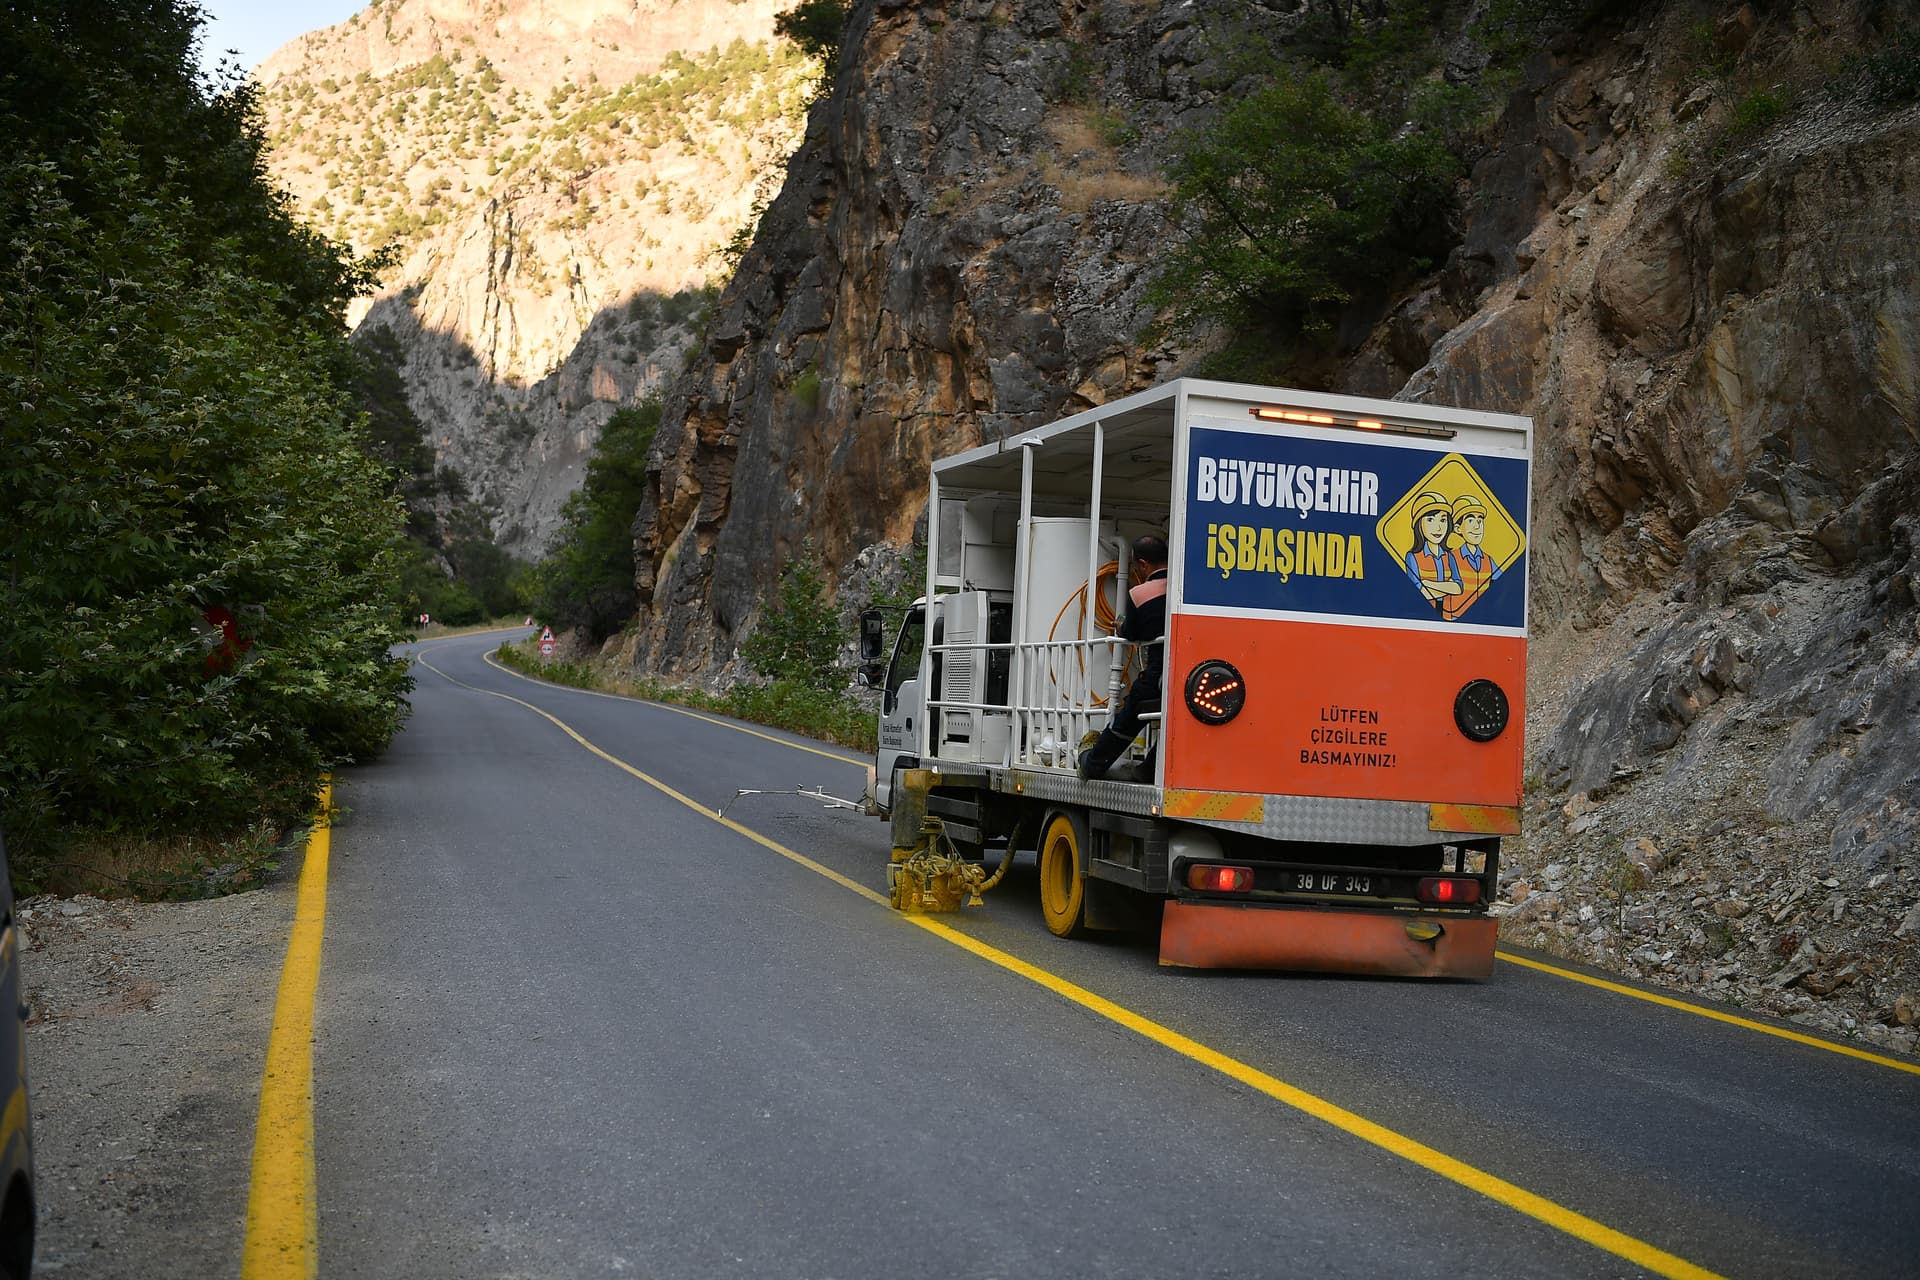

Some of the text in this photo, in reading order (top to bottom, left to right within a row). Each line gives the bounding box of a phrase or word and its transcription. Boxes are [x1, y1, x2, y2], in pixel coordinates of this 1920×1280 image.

[1197, 456, 1379, 519] BÜYÜKŞEHİR
[1206, 523, 1365, 583] İŞBAŞINDA
[1321, 705, 1378, 724] LÜTFEN
[1311, 726, 1387, 746] ÇİZGİLERE
[1300, 750, 1396, 767] BASMAYINIZ!
[1297, 874, 1370, 892] 38 UF 343
